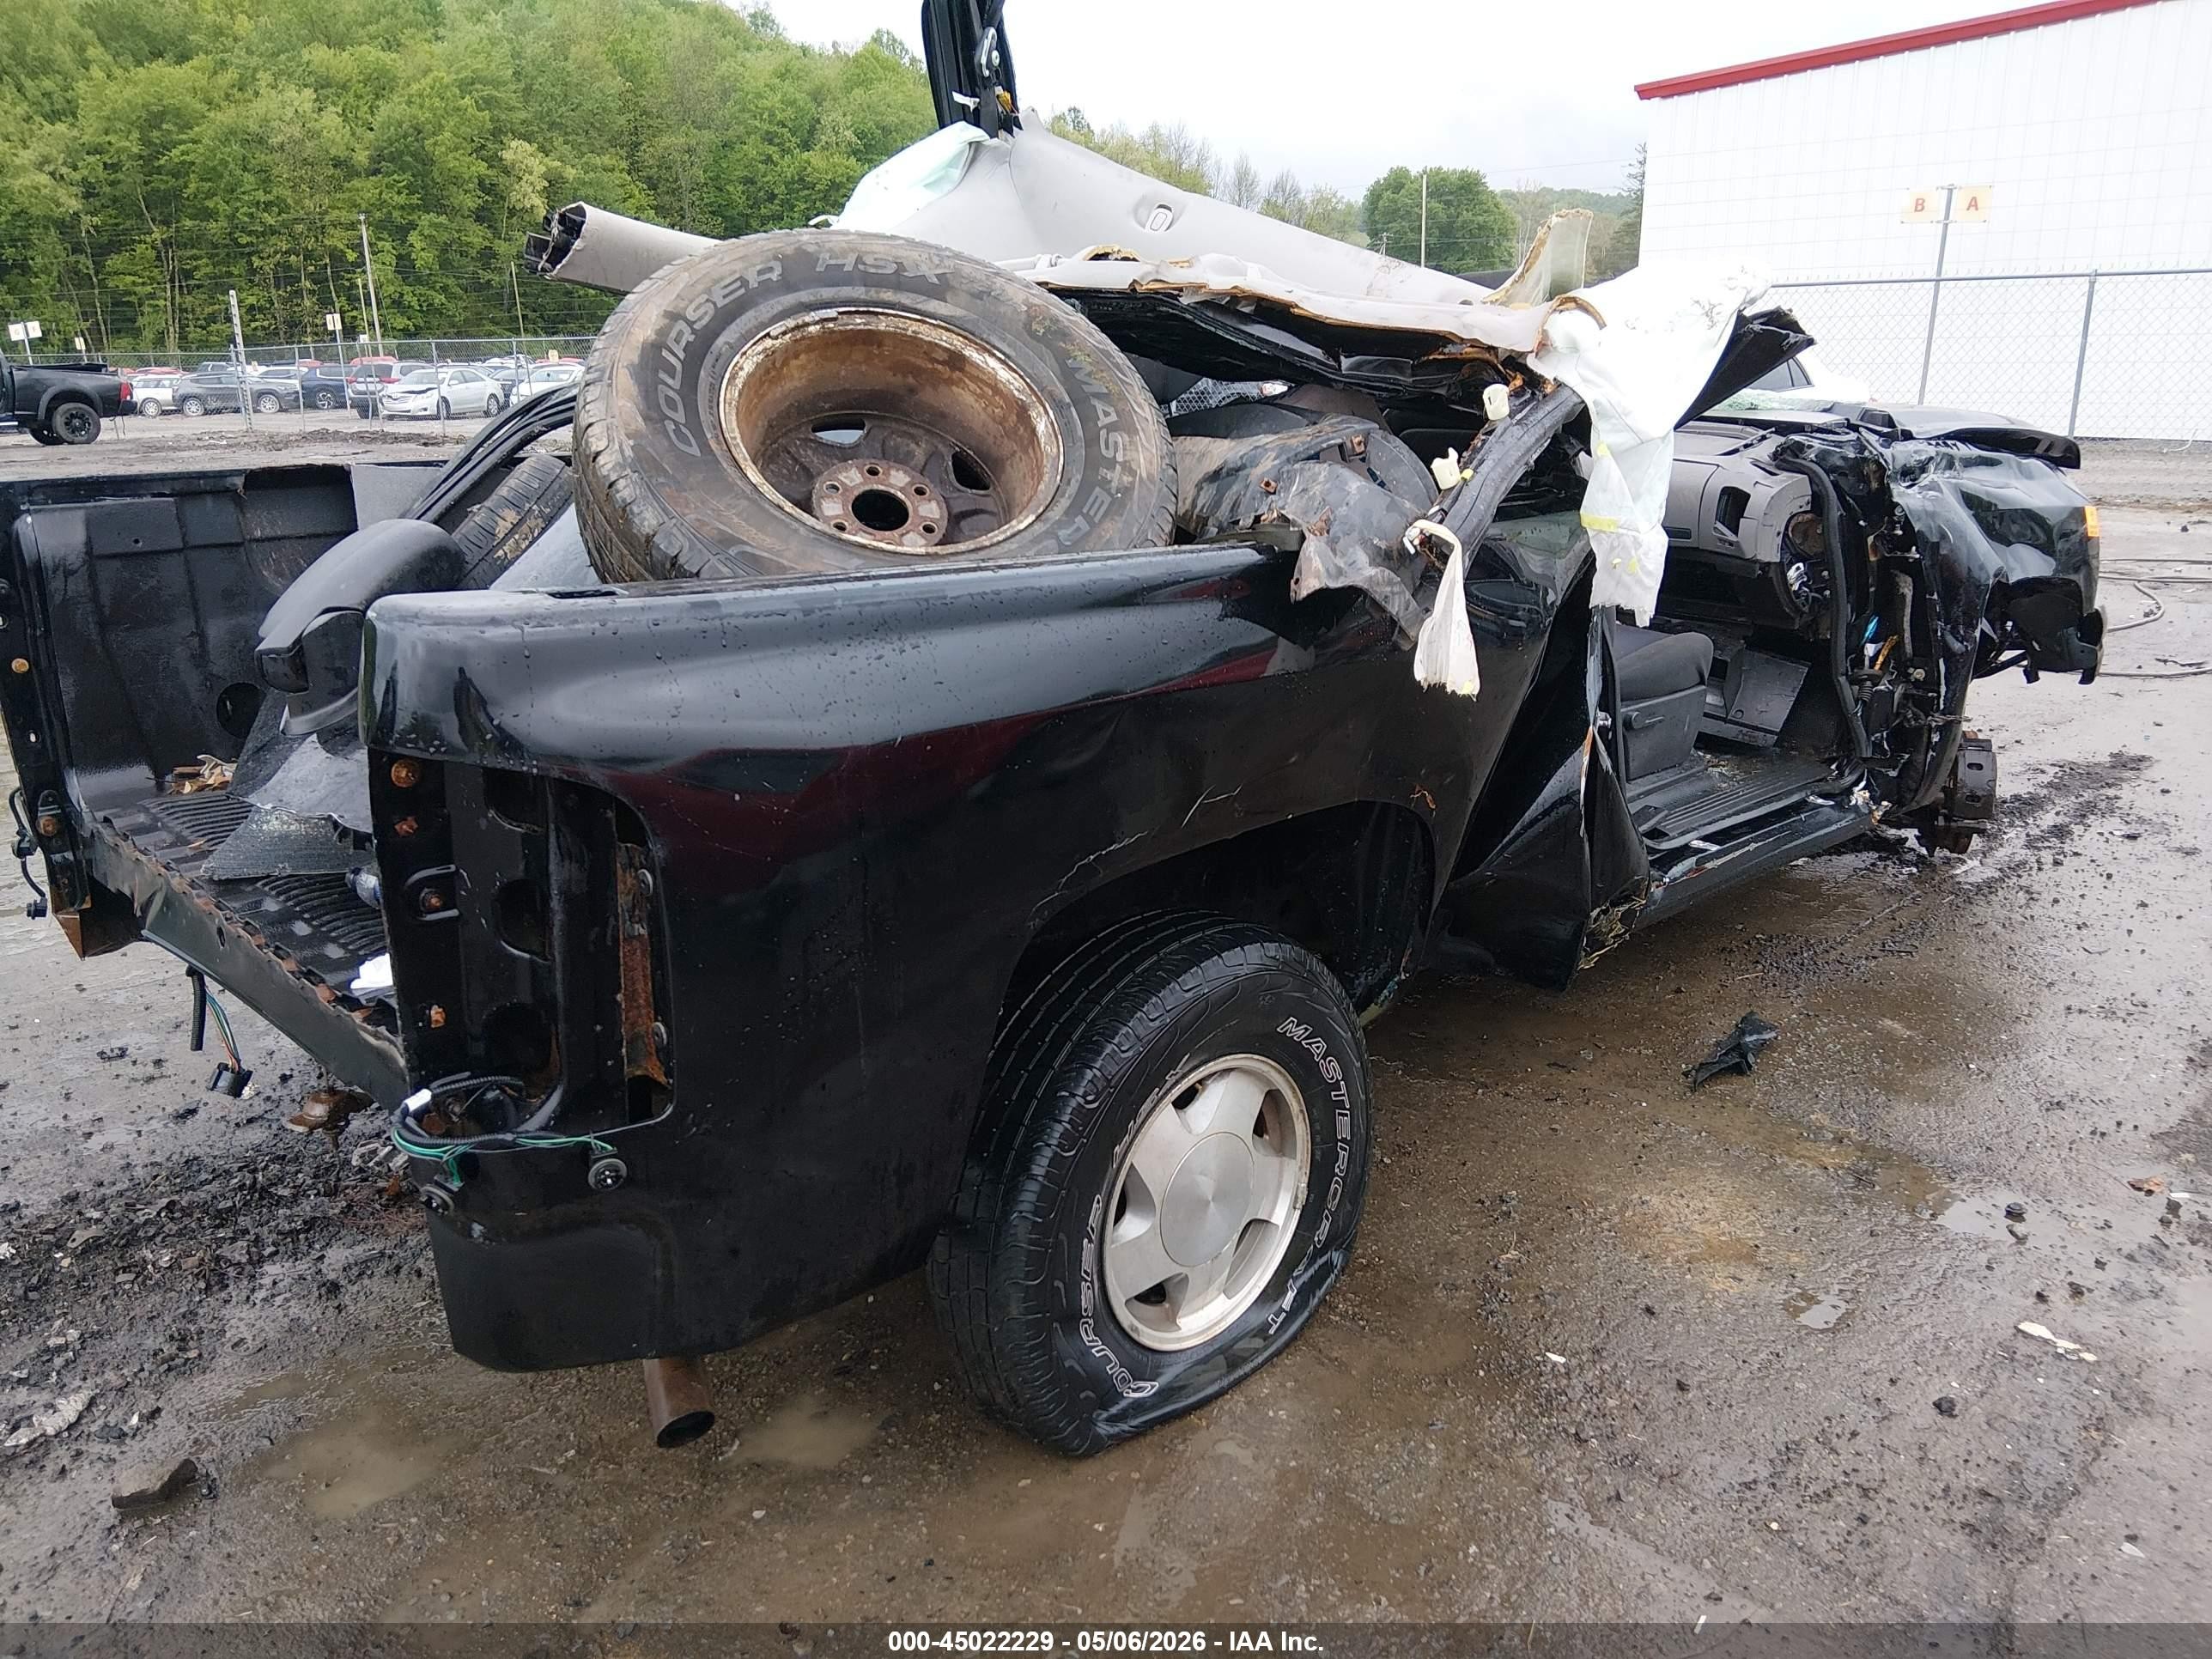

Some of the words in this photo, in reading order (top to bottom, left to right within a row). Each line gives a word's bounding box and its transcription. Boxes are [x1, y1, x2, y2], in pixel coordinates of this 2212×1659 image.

[1913, 198, 1926, 213] B
[1966, 196, 1980, 211] A
[658, 260, 783, 457] COURSER
[815, 252, 956, 285] HSX
[1079, 1194, 1159, 1398] COURSER
